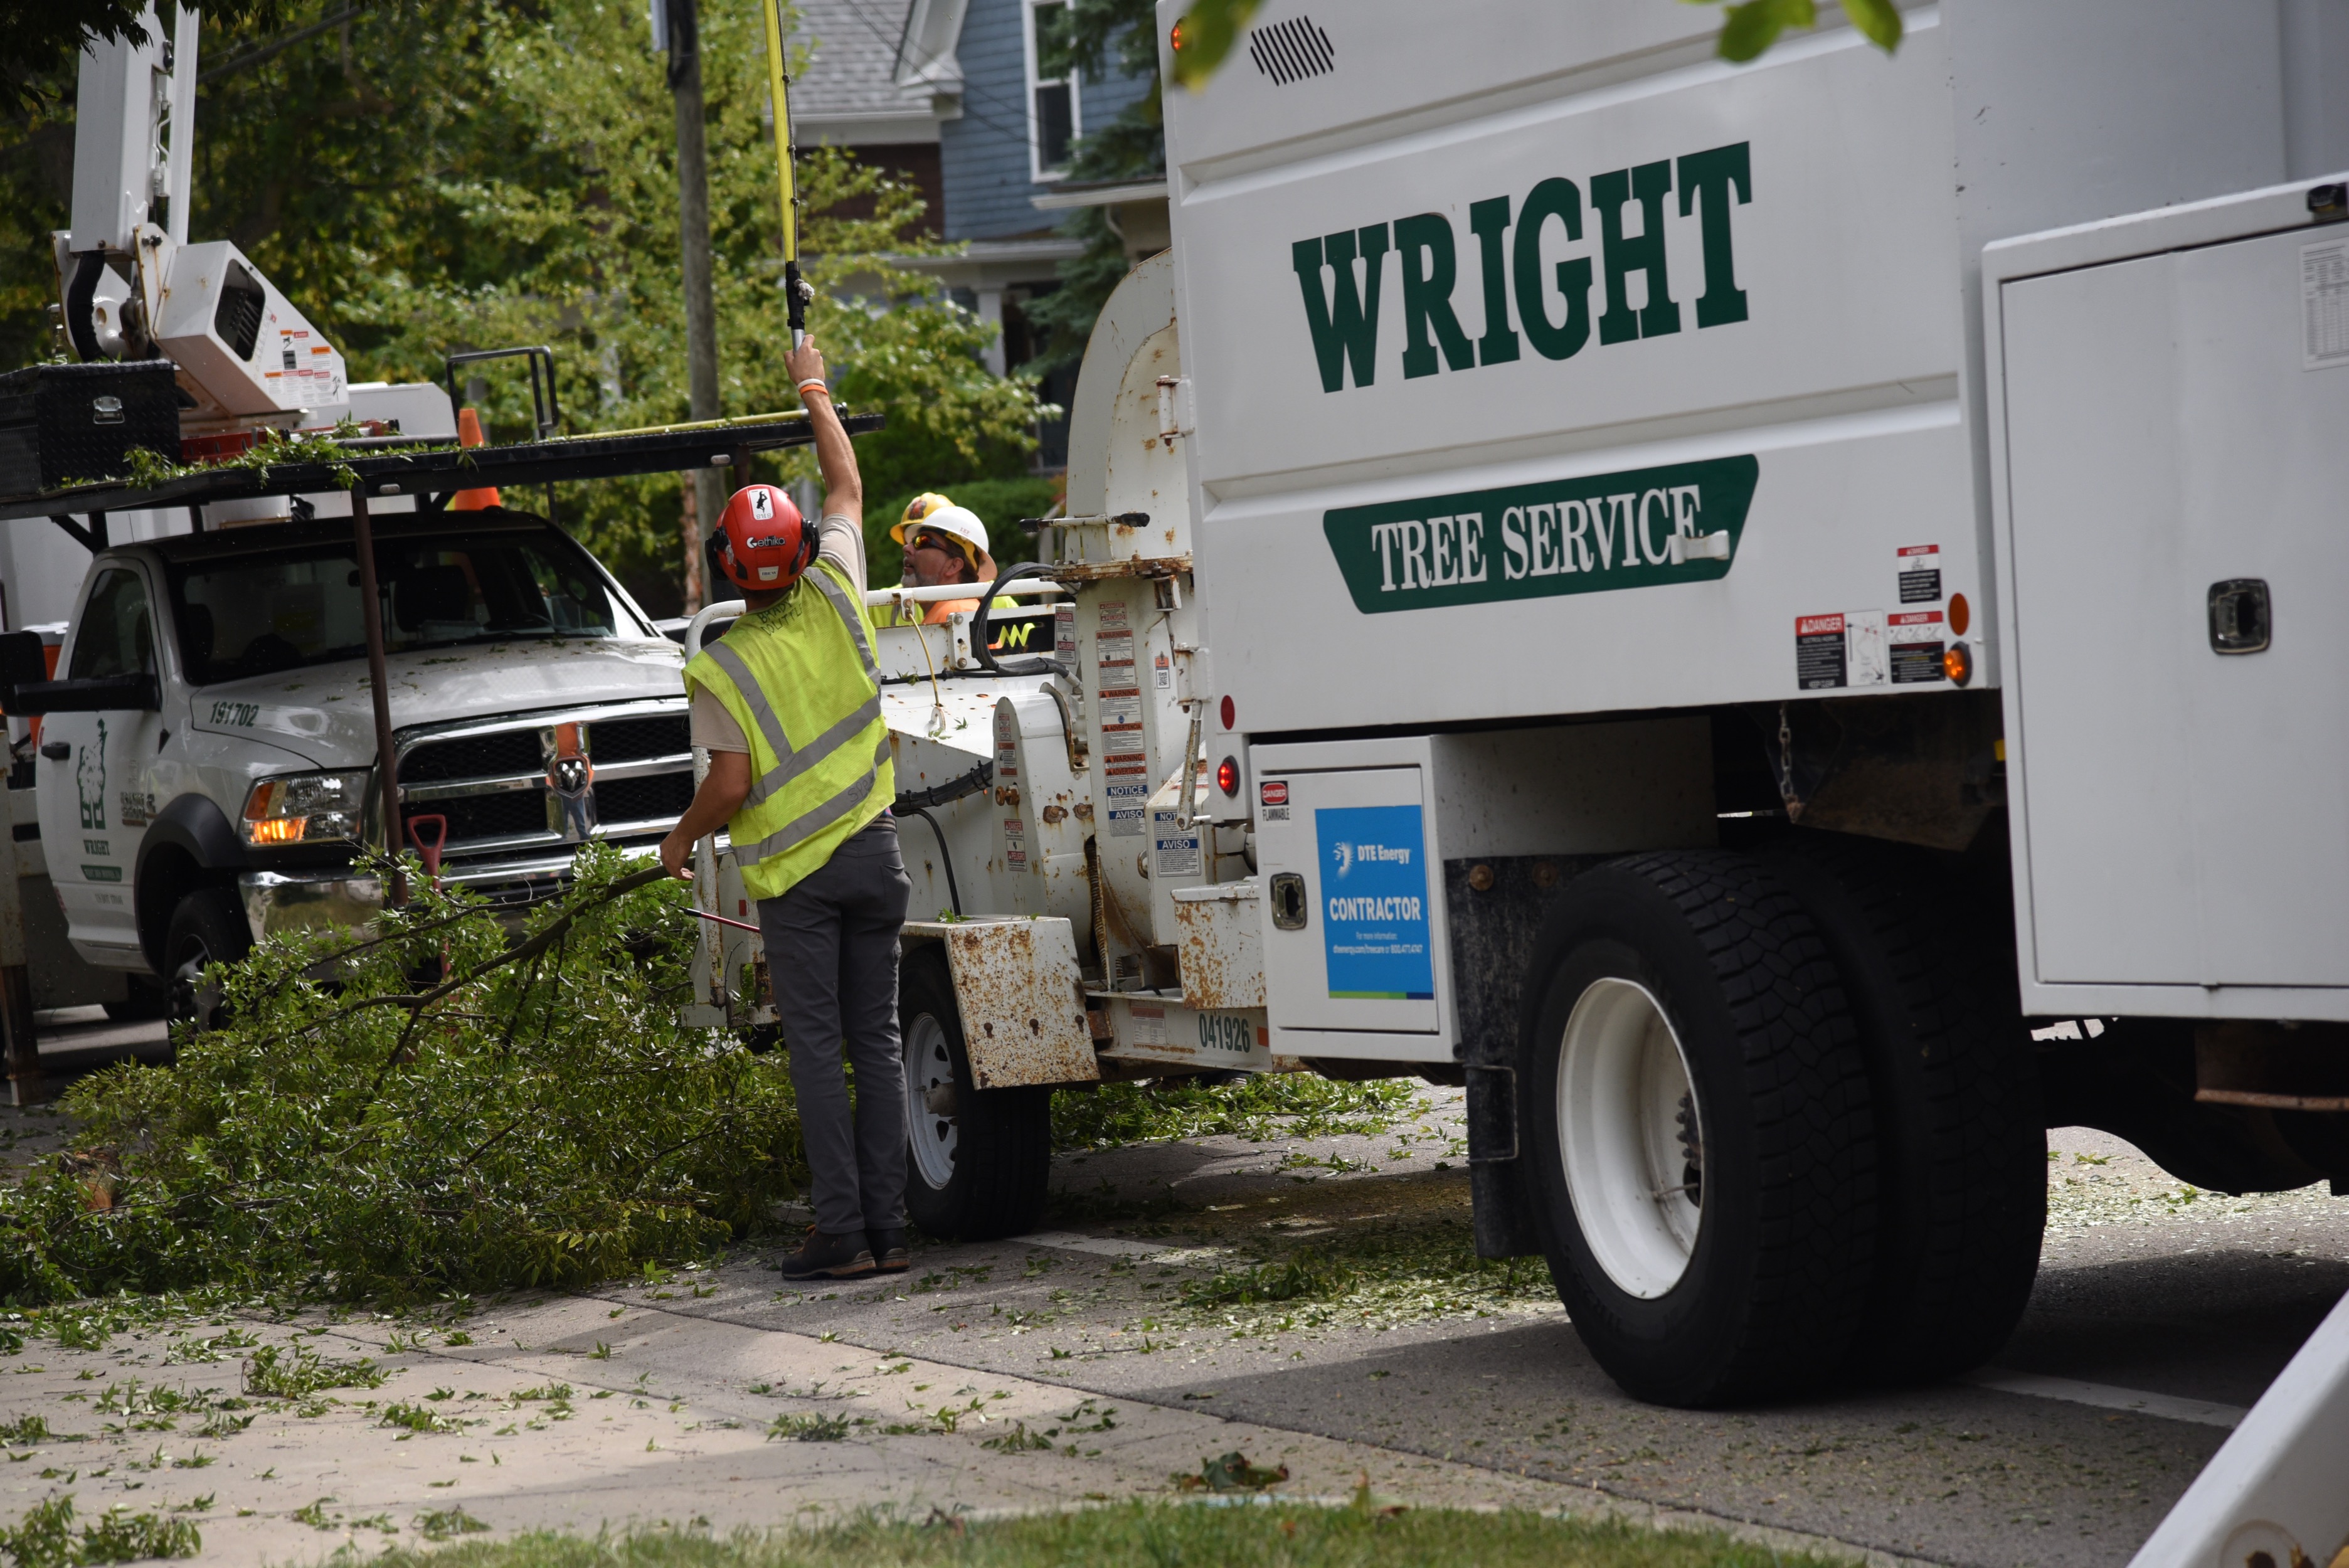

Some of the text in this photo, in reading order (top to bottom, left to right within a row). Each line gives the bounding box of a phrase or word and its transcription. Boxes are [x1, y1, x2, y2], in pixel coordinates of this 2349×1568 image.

[1292, 140, 1752, 393] WRIGHT
[757, 536, 785, 546] ethika
[1372, 484, 1704, 591] TREE SERVICE
[1808, 617, 1843, 632] DANGER
[209, 701, 259, 728] 191702
[1113, 753, 1142, 762] WARNING
[1110, 786, 1144, 795] NOTICE
[1263, 789, 1286, 798] DANGER
[1115, 810, 1143, 819] AVISO
[1160, 813, 1177, 821] NOT
[1263, 808, 1290, 822] FLAMMABLE
[1008, 822, 1022, 830] DANGER
[83, 839, 110, 856] WRIGHT
[1162, 840, 1190, 849] AVISO
[1357, 845, 1410, 865] DTE Energy
[1329, 896, 1421, 921] CONTRACTOR
[1199, 1013, 1251, 1053] 041926
